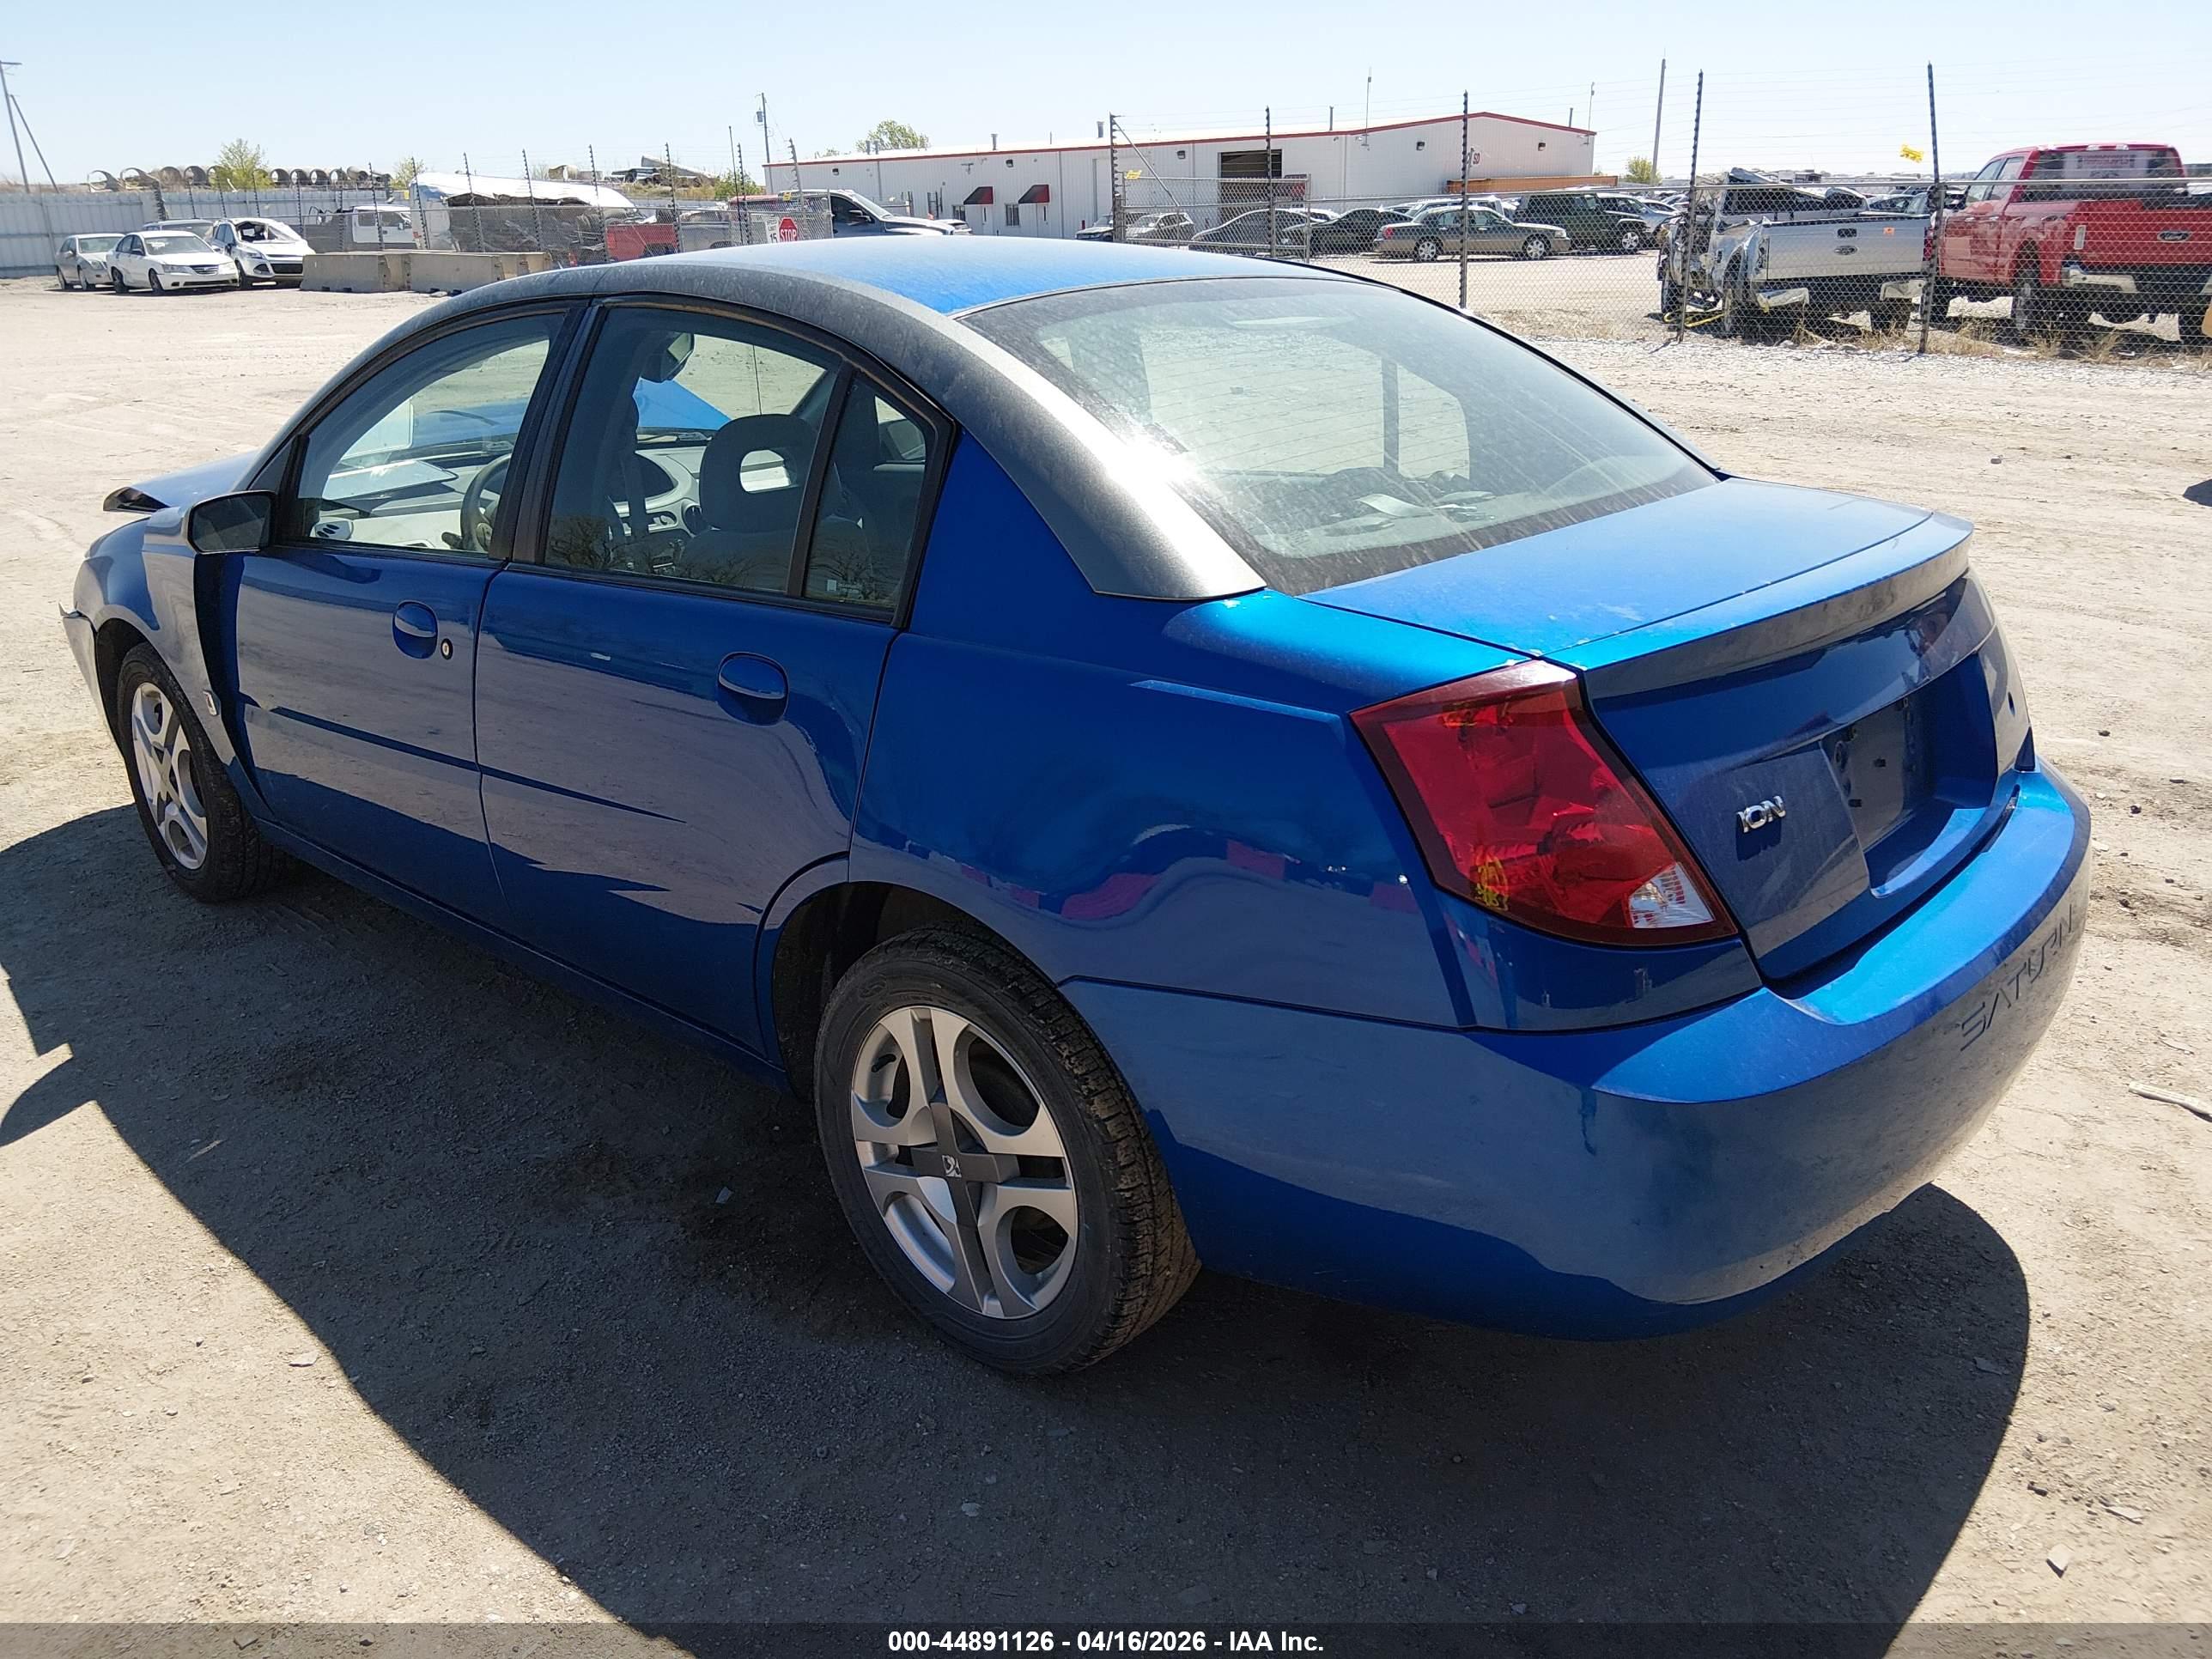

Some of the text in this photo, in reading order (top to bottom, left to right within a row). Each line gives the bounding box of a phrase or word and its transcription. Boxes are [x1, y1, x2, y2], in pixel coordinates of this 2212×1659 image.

[781, 228, 797, 242] STOP
[1736, 795, 1786, 834] ION
[1960, 903, 2073, 1052] SATURN
